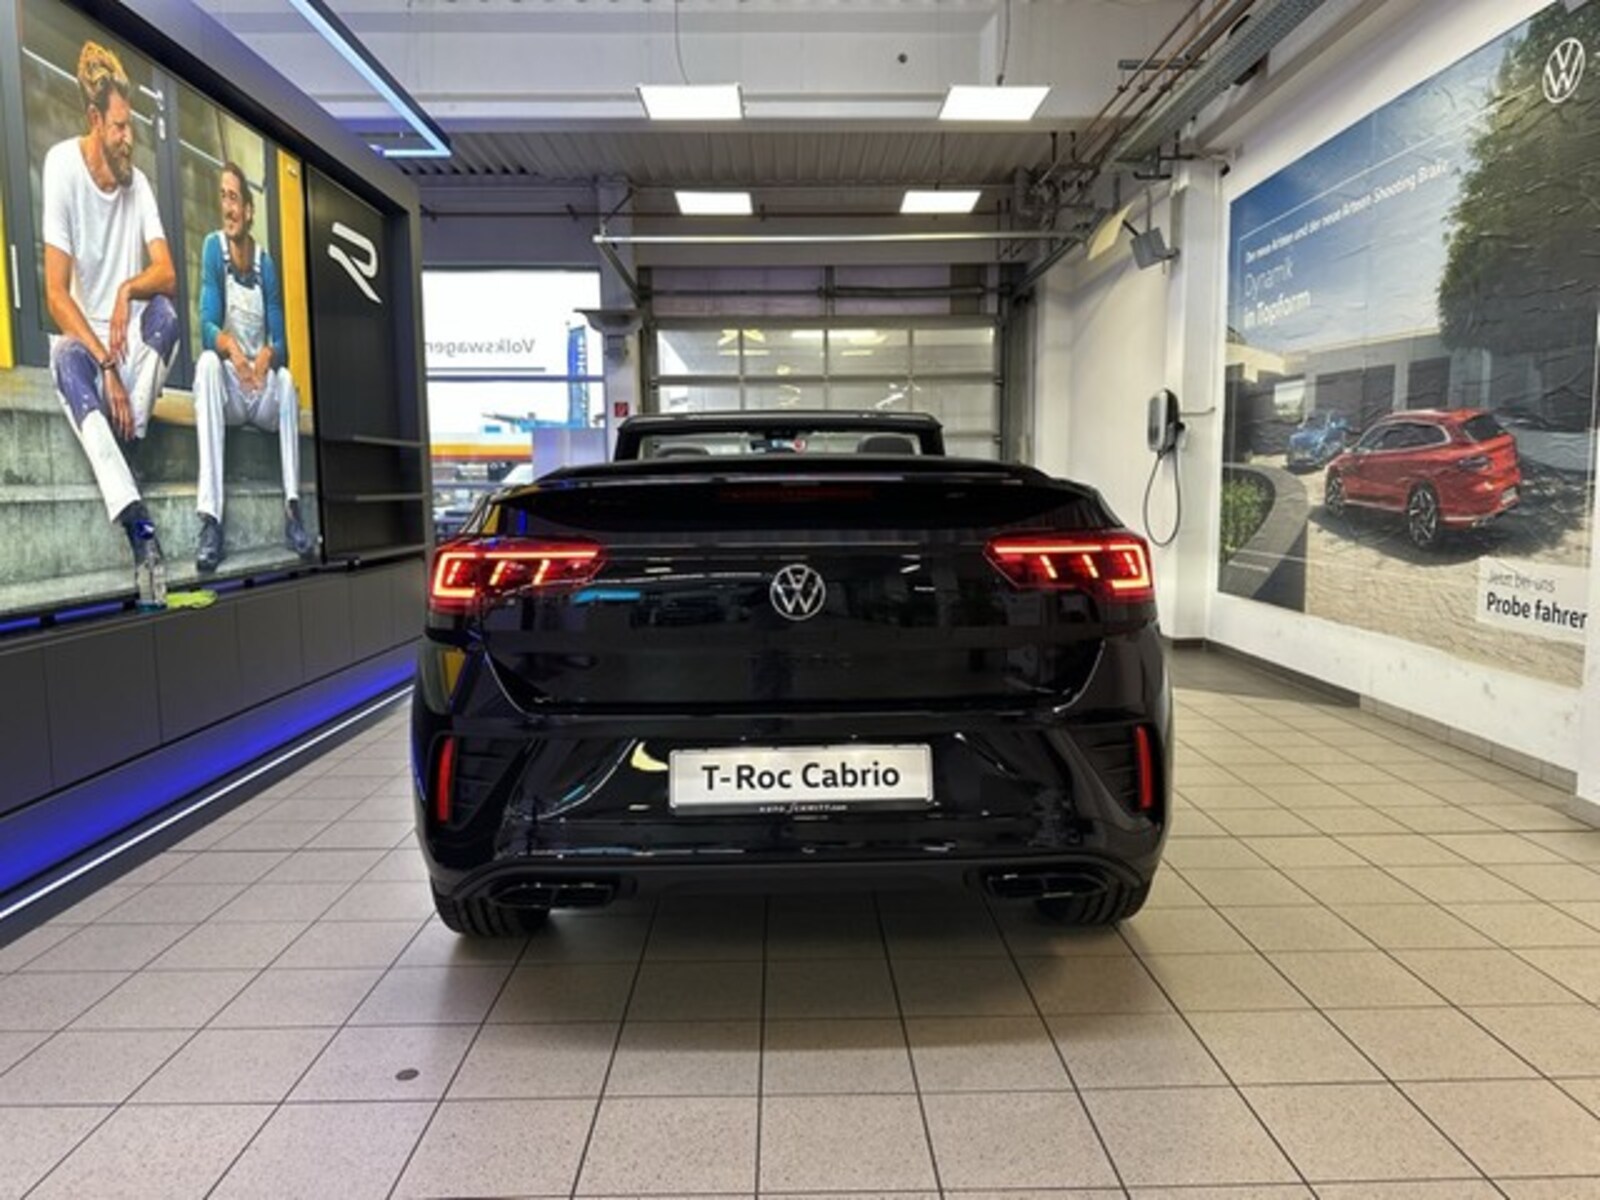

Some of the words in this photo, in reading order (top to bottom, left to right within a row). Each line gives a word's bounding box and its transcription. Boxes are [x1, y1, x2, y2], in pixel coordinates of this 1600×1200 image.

[1245, 256, 1293, 300] Dynamik
[1257, 290, 1311, 327] Topform
[1486, 591, 1531, 619] Probe
[702, 764, 793, 791] T-Roc
[801, 760, 901, 789] Cabrio
